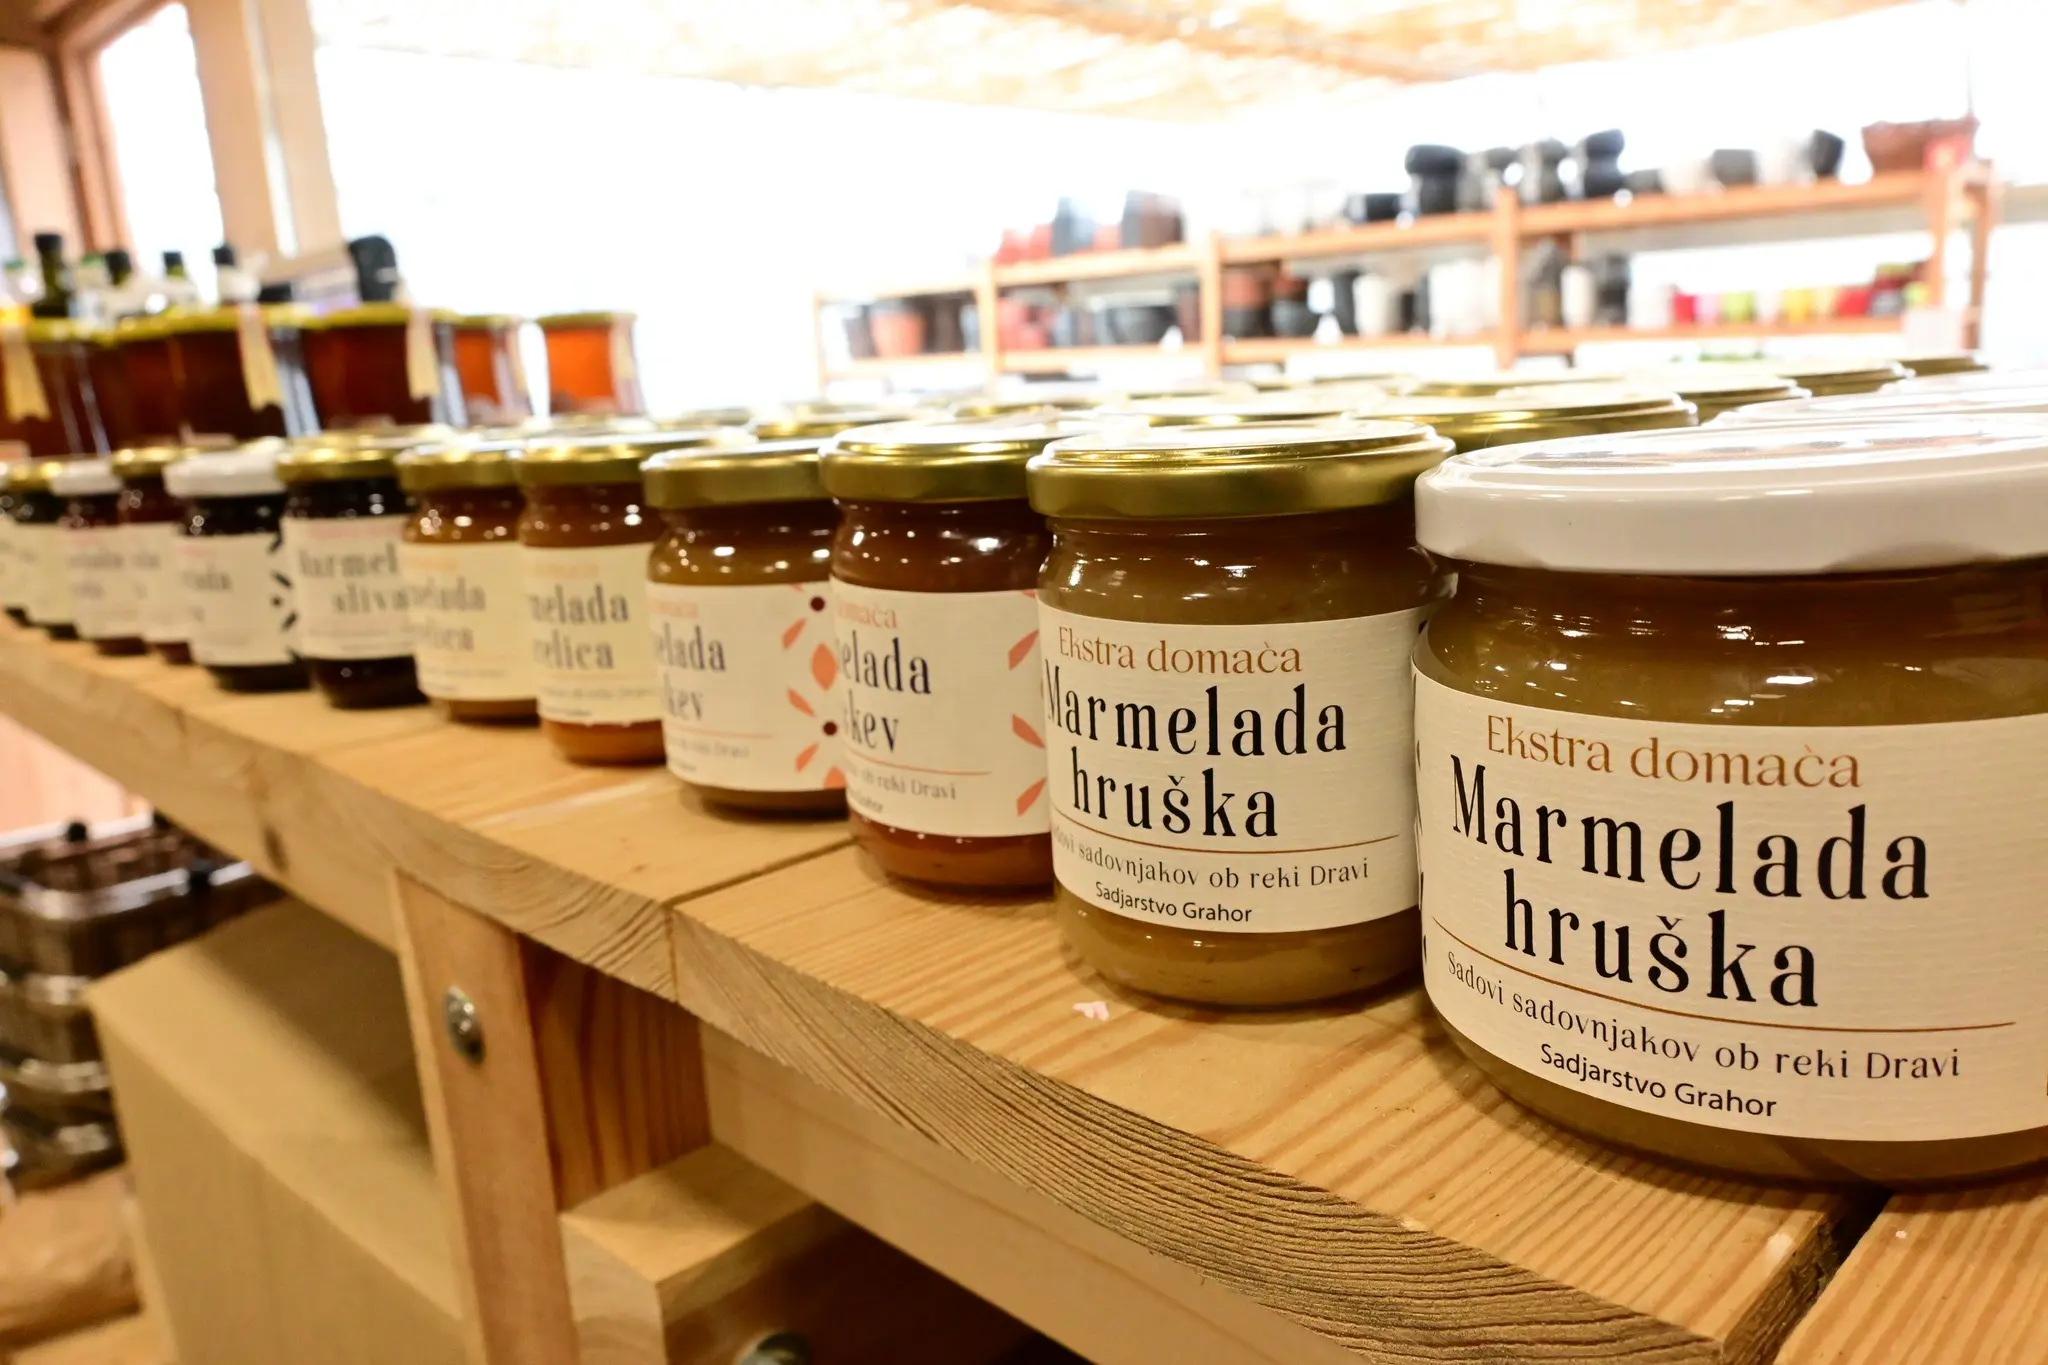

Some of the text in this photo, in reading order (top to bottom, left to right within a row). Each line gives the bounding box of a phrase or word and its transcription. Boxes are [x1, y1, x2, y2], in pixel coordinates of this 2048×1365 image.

[1058, 625, 1136, 671] Ekstra
[1044, 657, 1347, 757] Marmelada
[1486, 713, 1613, 774] Ekstra
[1071, 745, 1279, 838] hruška
[1449, 754, 1931, 901] Marmelada
[1078, 842, 1199, 886] sadovnjakov
[1208, 866, 1240, 889] ob
[1250, 866, 1301, 889] reki
[1310, 857, 1369, 887] Dravi
[1095, 881, 1253, 923] Sadjarstvo Grahor
[1502, 867, 1820, 1008] hruška
[1447, 950, 1961, 1080] Sadovi sadovnjakov ob reki Dravi
[1540, 1042, 1779, 1119] Sadjarstvo Grahor
